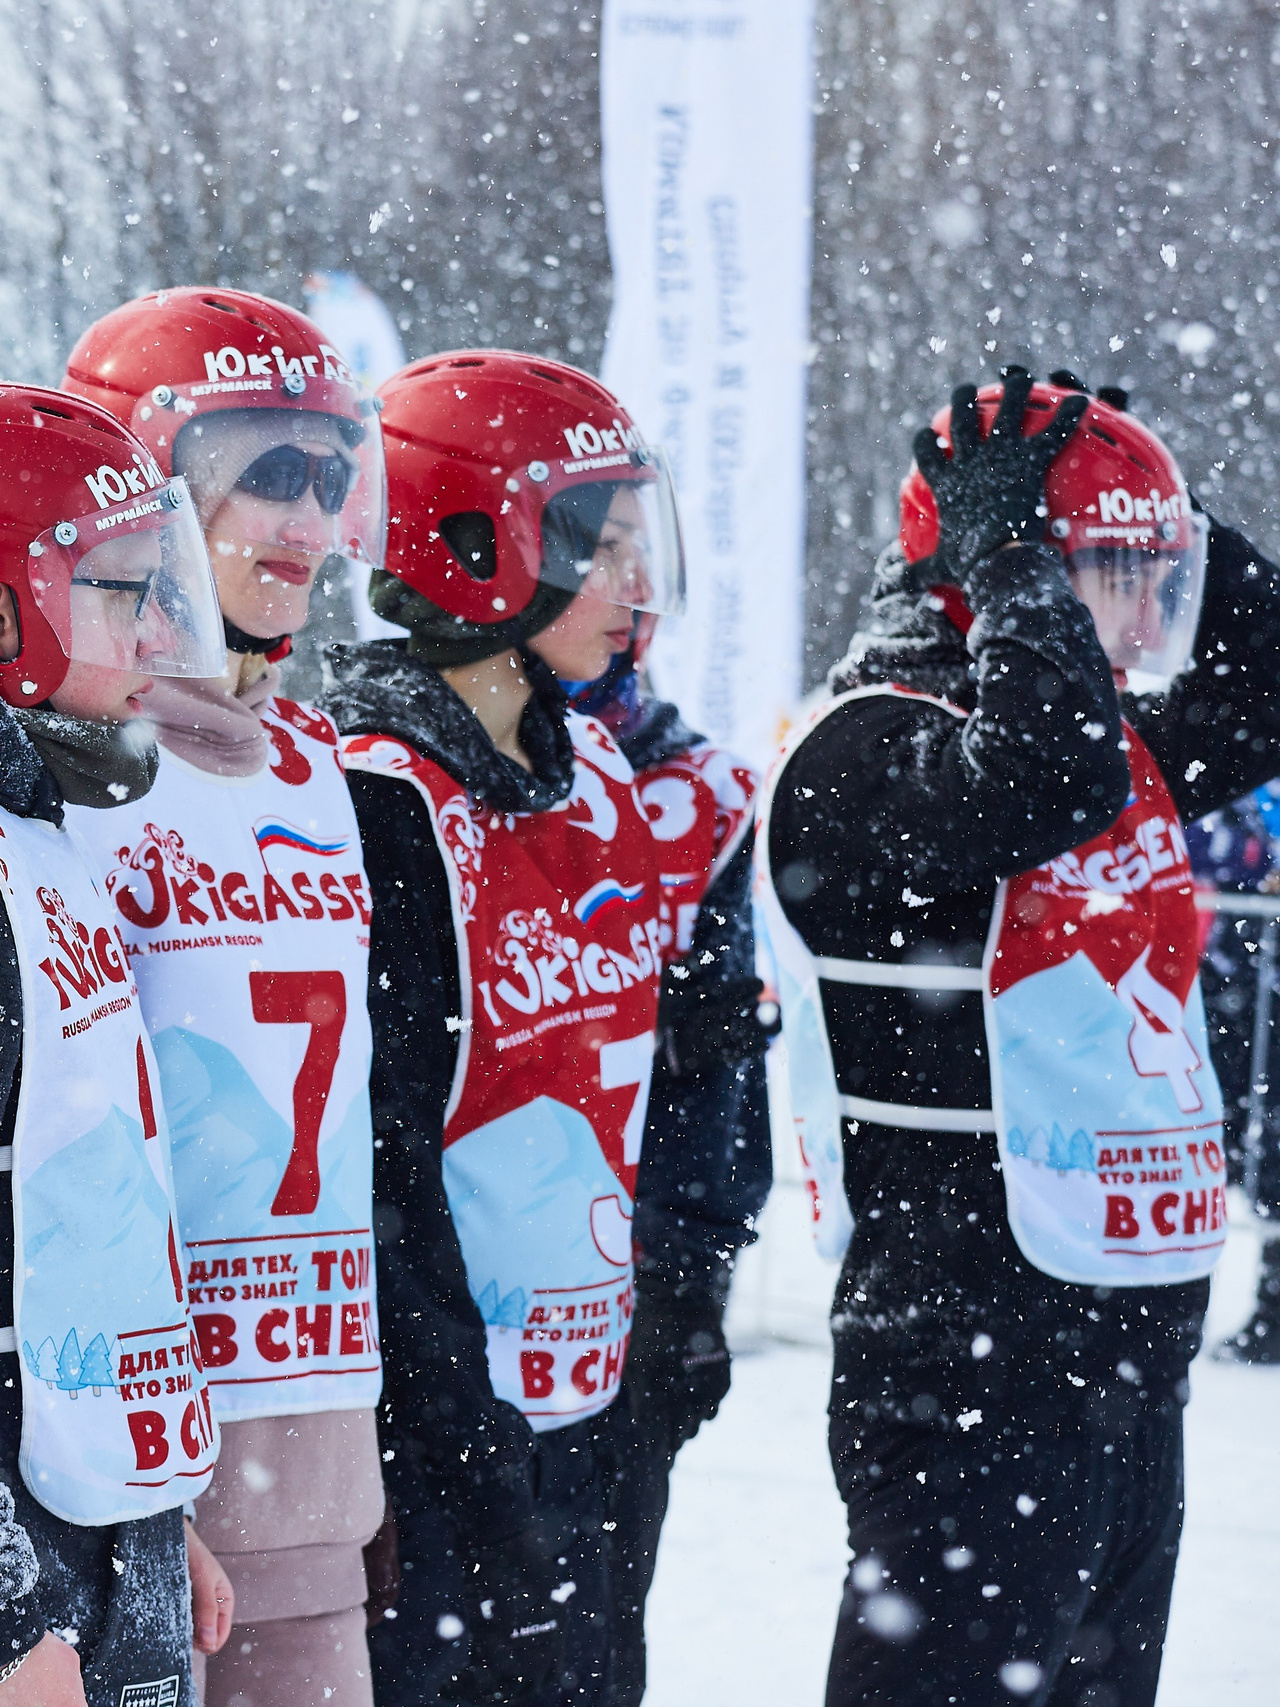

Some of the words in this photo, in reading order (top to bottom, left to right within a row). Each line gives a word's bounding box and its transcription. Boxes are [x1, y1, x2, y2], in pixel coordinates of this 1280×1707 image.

[191, 381, 272, 397] МУРМАНСК
[95, 499, 164, 531] МУРМАНСК
[149, 934, 225, 953] MURMANSK
[226, 935, 263, 948] REGION
[249, 970, 346, 1217] 7
[1097, 1148, 1142, 1167] ДЛЯ
[1097, 1171, 1134, 1184] КТО
[1103, 1194, 1140, 1239] В
[187, 1257, 248, 1285] ДЛЯ
[252, 1253, 299, 1276] ТЕХ,
[187, 1285, 237, 1305] КТО
[241, 1280, 298, 1300] ЗНАЕТ
[192, 1313, 239, 1368] В
[523, 1328, 562, 1341] КТО
[118, 1348, 169, 1379] ДЛЯ
[520, 1350, 555, 1399] В
[120, 1378, 162, 1402] КТО
[127, 1410, 170, 1471] В
[126, 1686, 159, 1697] OFFICIAL
